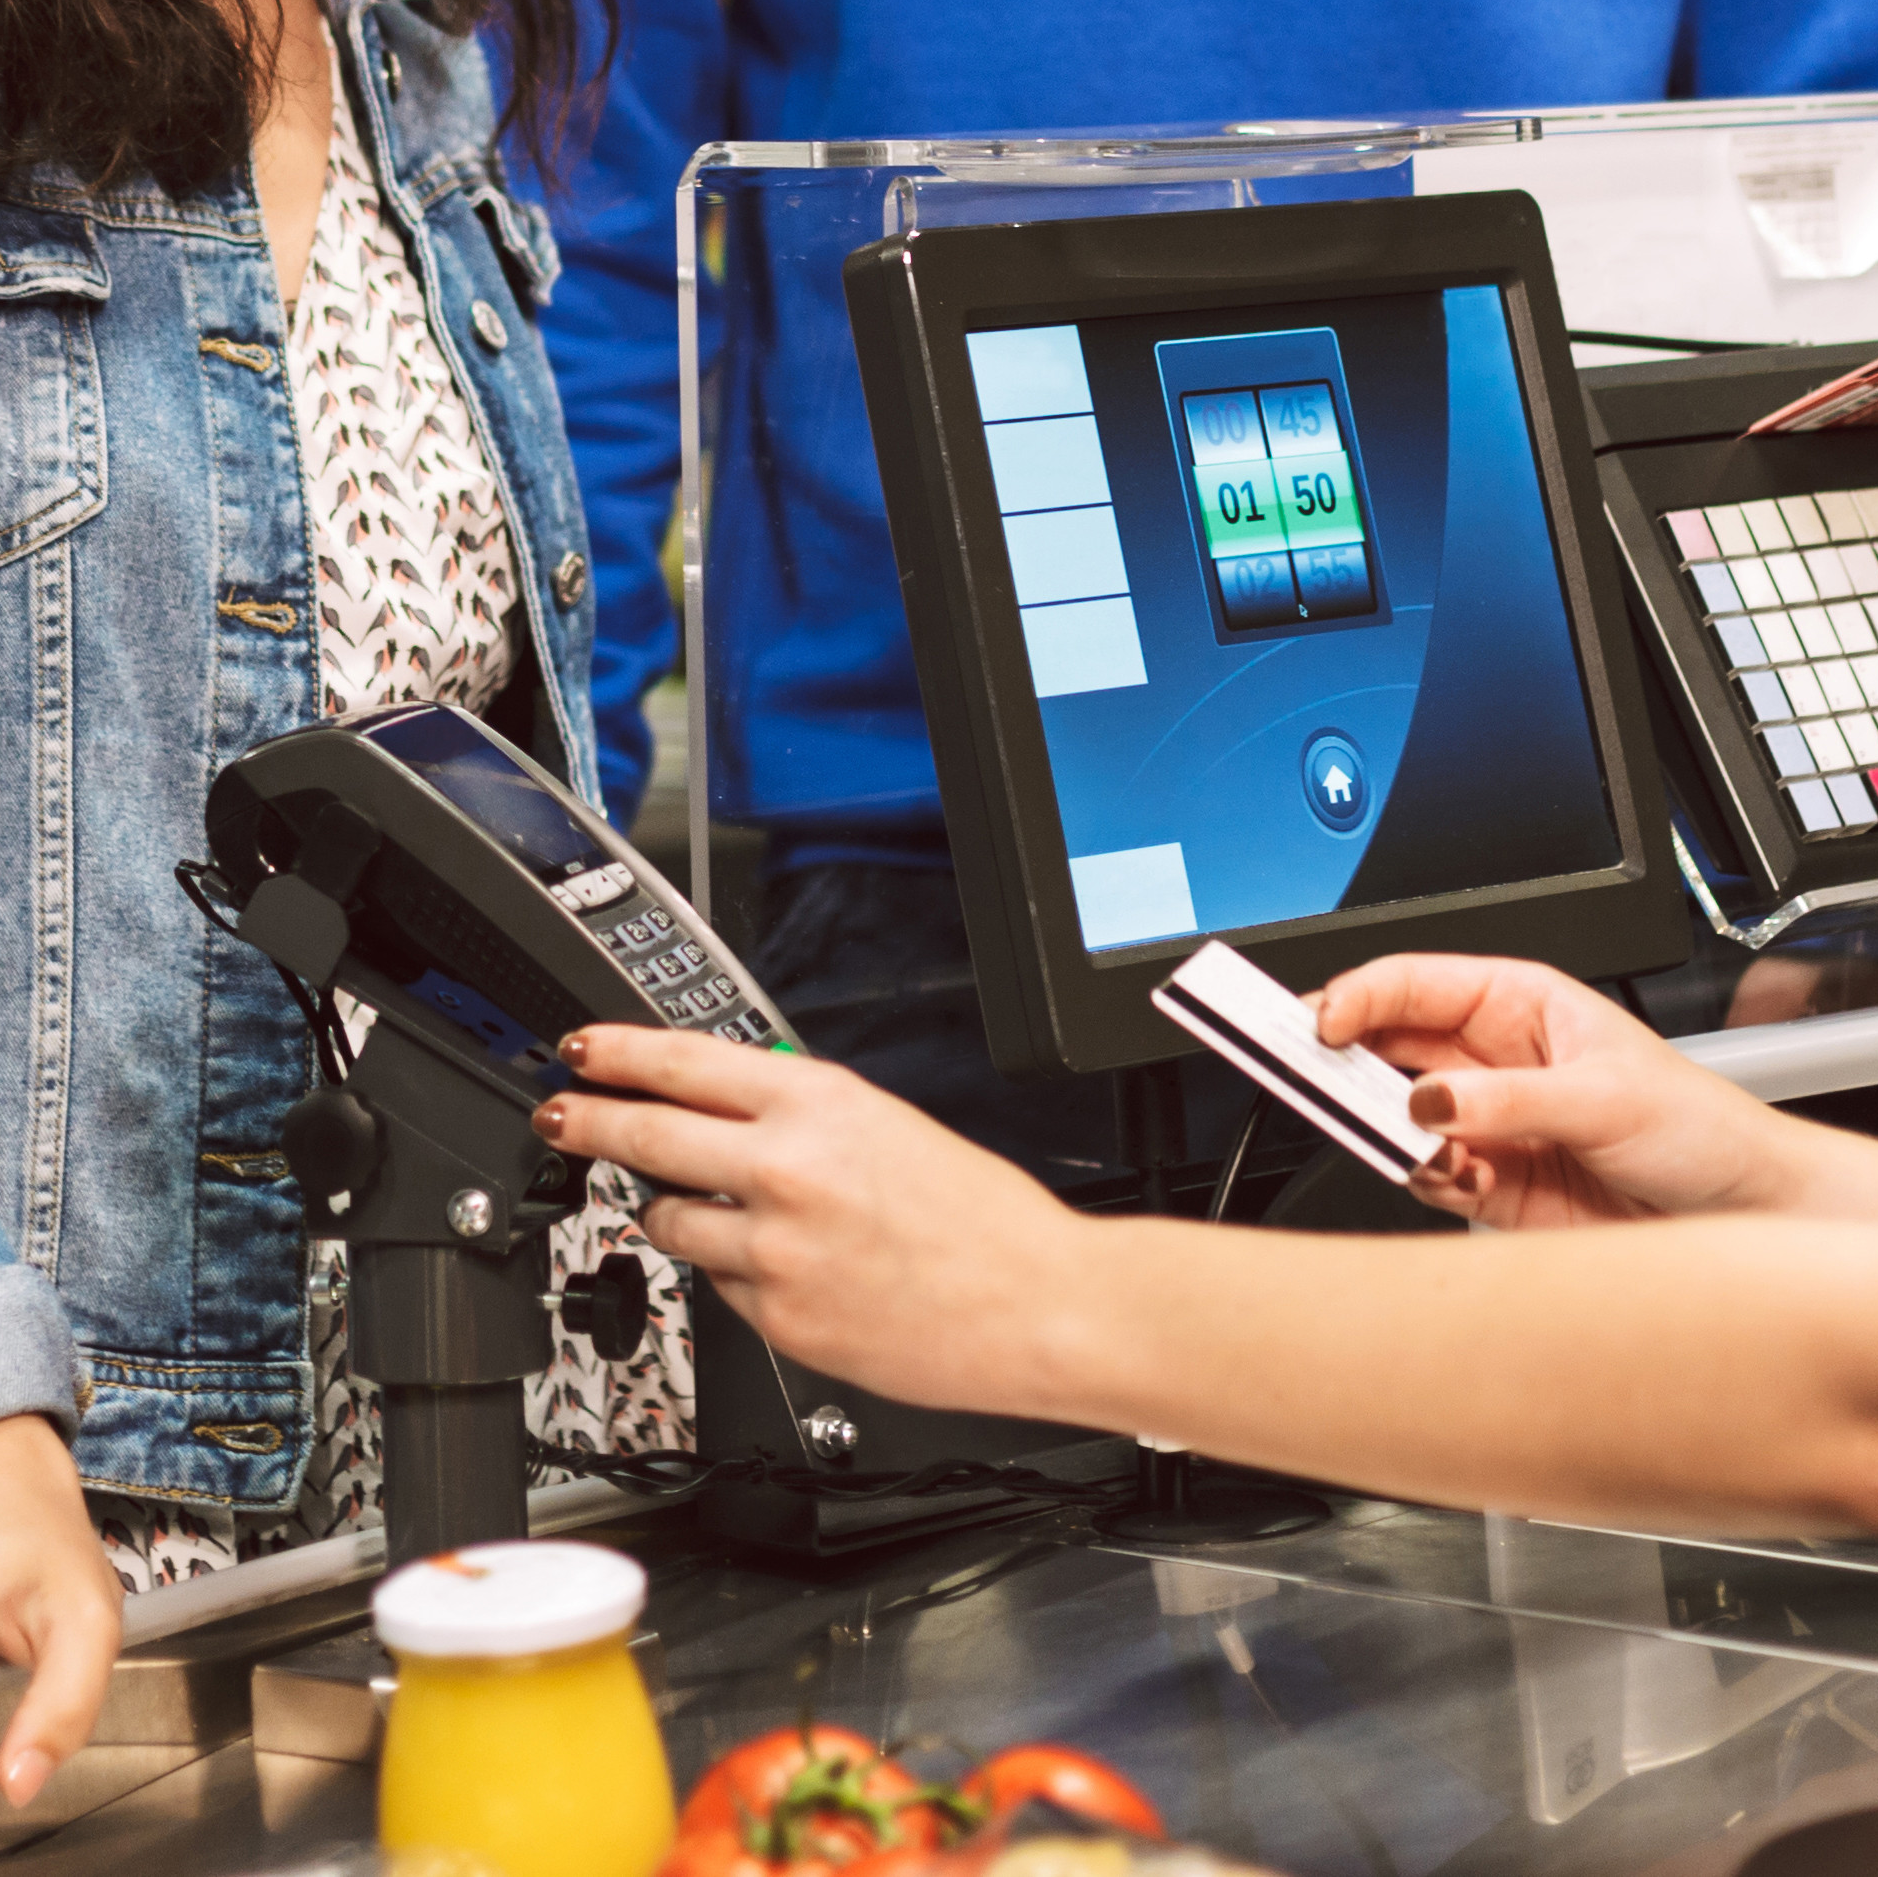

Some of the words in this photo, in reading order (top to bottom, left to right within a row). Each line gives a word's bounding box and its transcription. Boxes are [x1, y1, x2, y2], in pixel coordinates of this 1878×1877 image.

[1203, 402, 1245, 445] 00
[1279, 395, 1321, 438] 45
[1218, 480, 1265, 524] 01
[1292, 472, 1337, 516] 50
[1234, 557, 1277, 600] 02
[1309, 549, 1354, 592] 55
